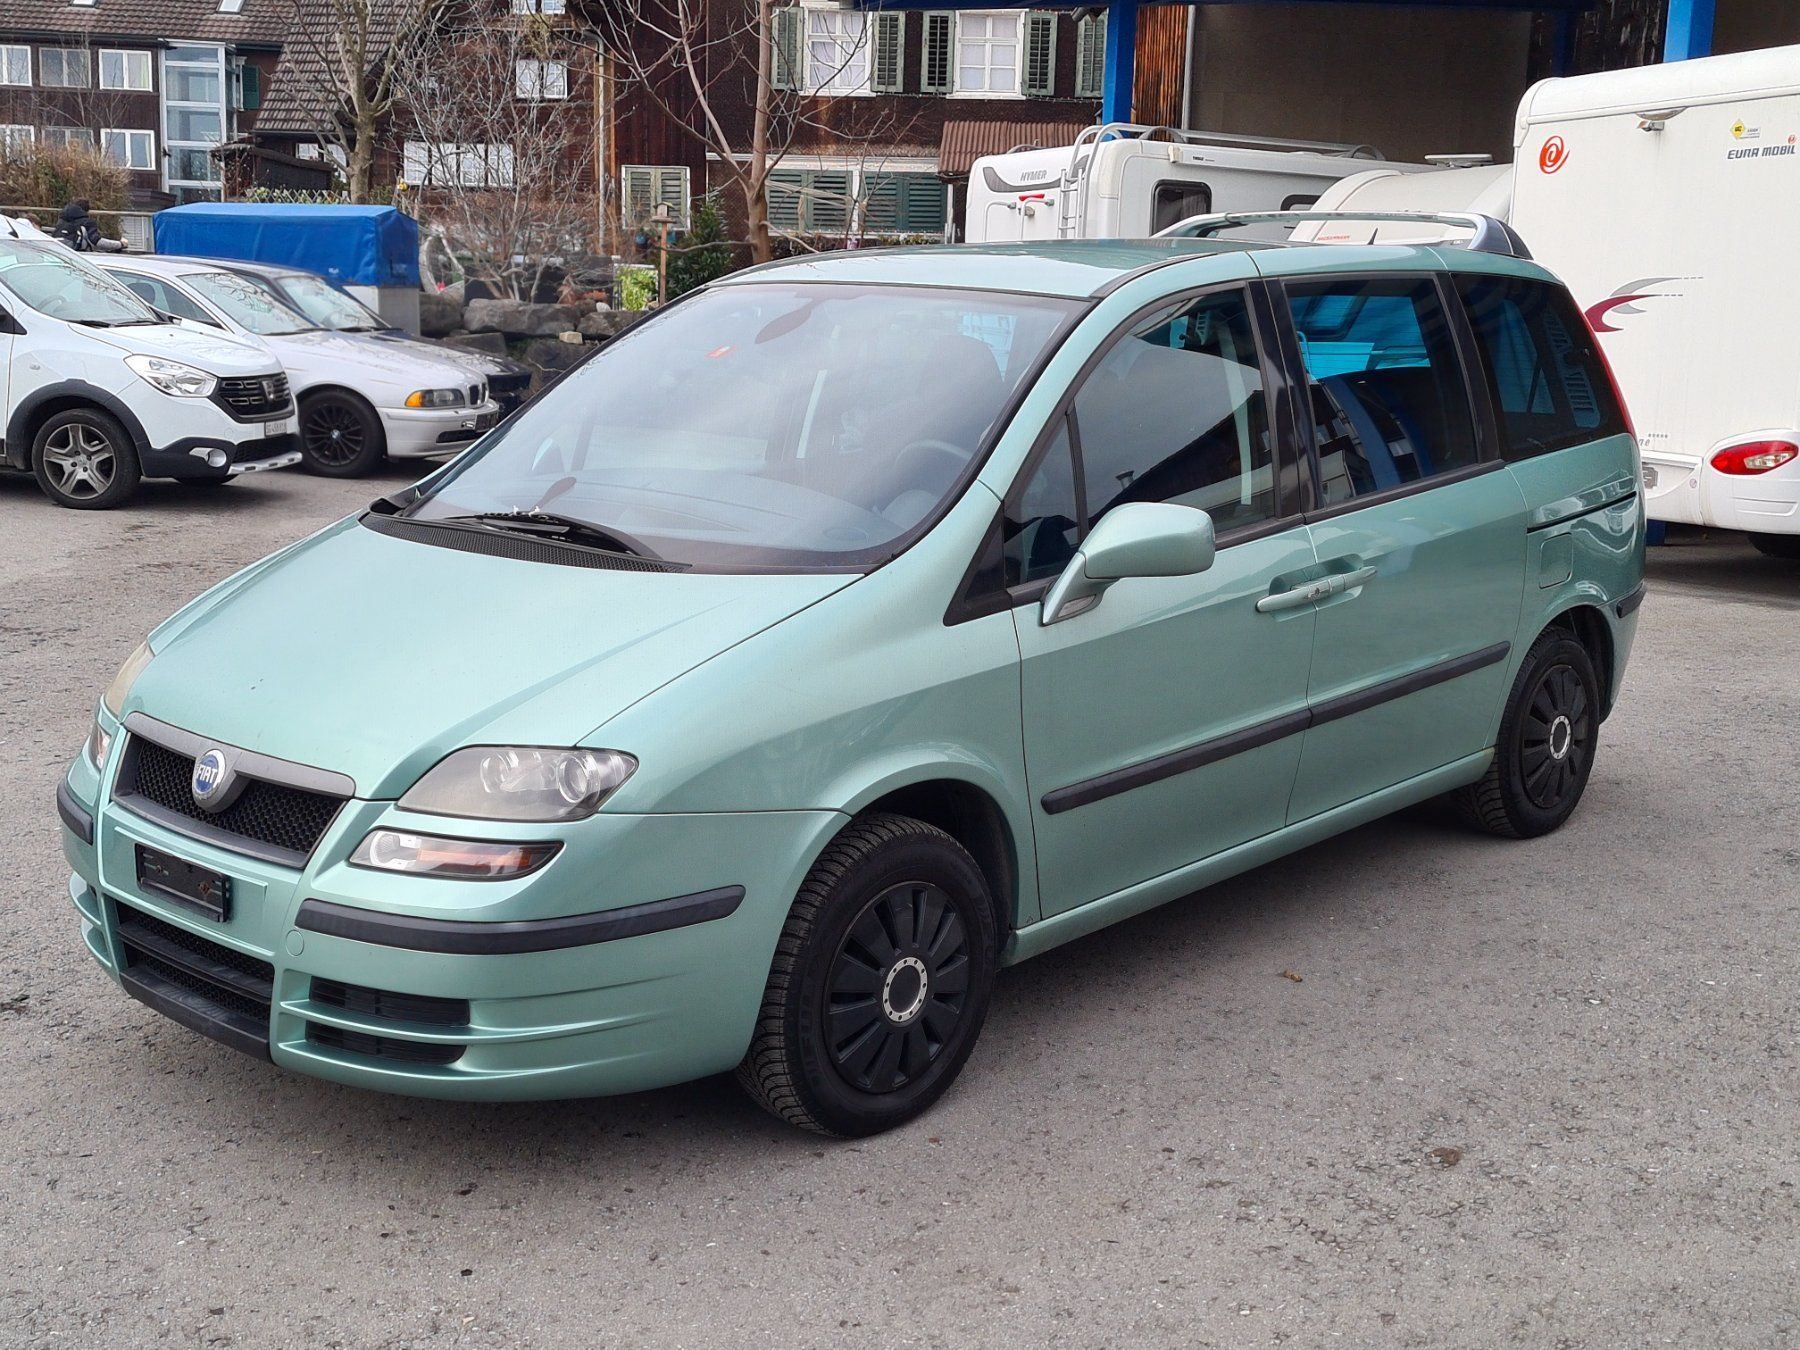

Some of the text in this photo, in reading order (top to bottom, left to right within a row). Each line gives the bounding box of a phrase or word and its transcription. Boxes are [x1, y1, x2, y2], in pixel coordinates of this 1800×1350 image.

[1761, 145, 1796, 157] MOBIL
[1020, 169, 1048, 182] HYMER
[196, 763, 218, 784] FIAT
